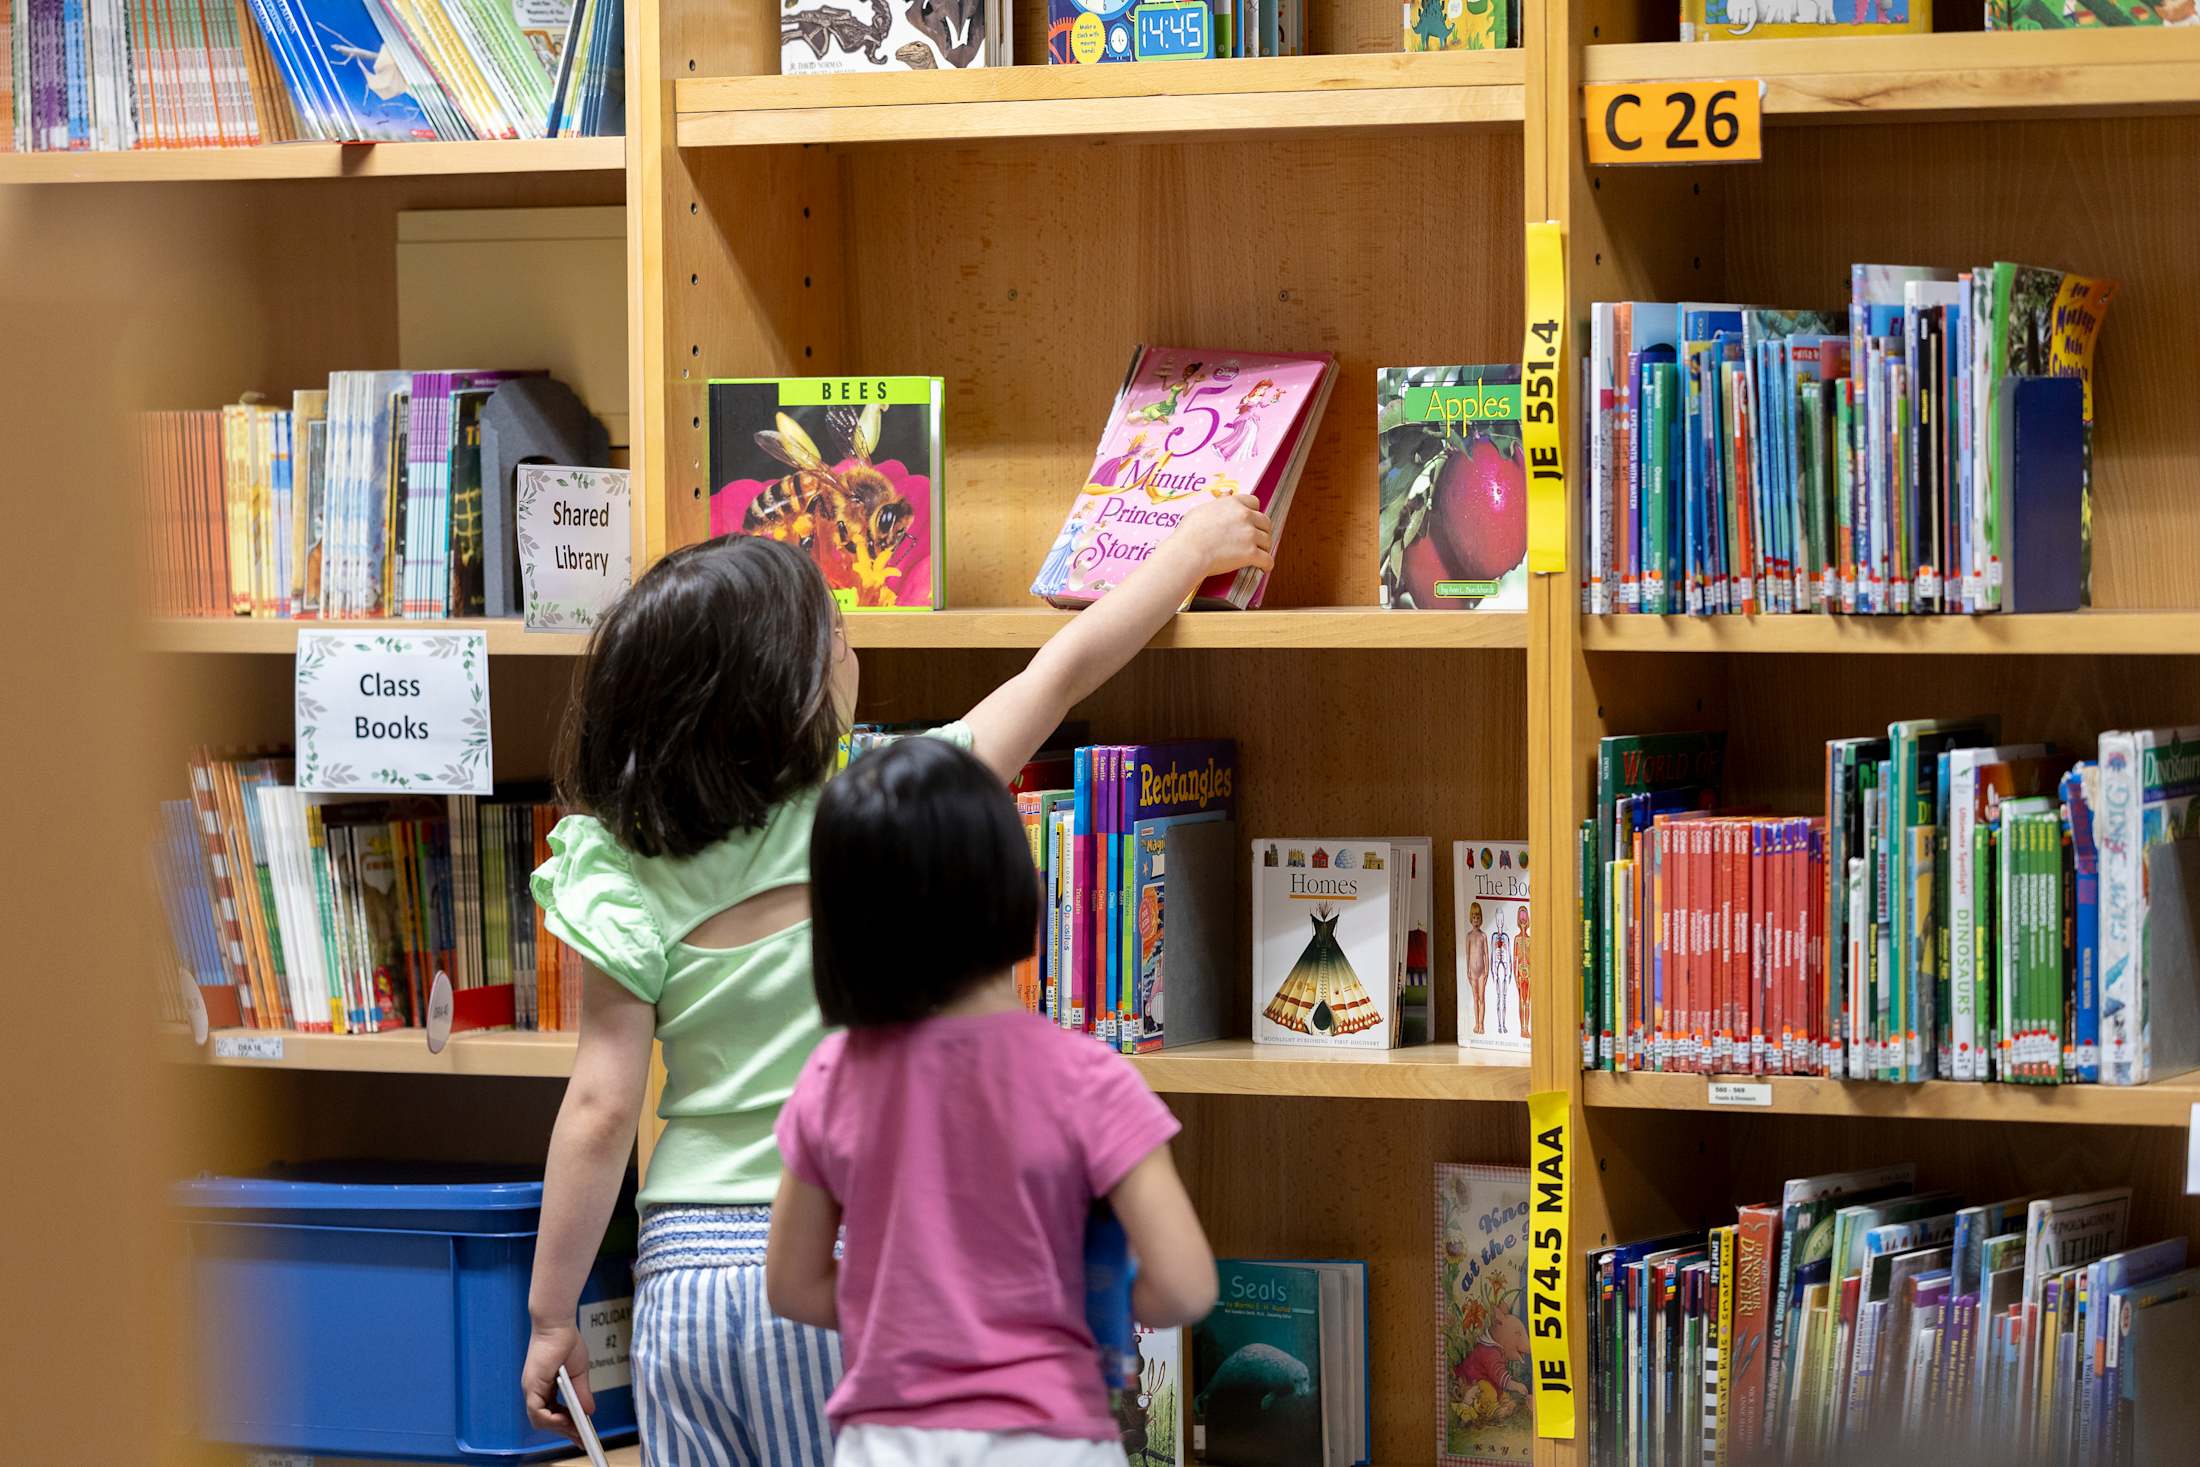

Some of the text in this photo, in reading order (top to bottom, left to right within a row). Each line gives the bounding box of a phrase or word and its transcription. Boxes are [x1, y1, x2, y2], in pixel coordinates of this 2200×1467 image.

[1142, 12, 1201, 49] 14:45
[1604, 90, 1740, 151] C 26
[822, 381, 887, 400] BEES
[1526, 319, 1564, 481] JE 551.4
[1164, 384, 1233, 458] 5
[1425, 377, 1511, 438] Apples
[1120, 459, 1207, 492] Minute
[1629, 408, 1637, 510] EXPERIMENTS WITH WATER
[553, 500, 609, 527] Shared
[555, 545, 609, 576] Library
[360, 672, 420, 697] Class
[355, 715, 429, 740] Books
[1139, 758, 1232, 808] Rectangles
[1290, 873, 1358, 896] Homes
[1474, 874, 1531, 897] The Bo
[1956, 807, 1970, 1016] Ultimate Spotlight DINOSAURS
[1479, 1201, 1529, 1234] Kno
[1783, 1231, 1792, 1247] MY
[1462, 1234, 1517, 1292] at the
[1534, 1125, 1573, 1394] JE 574.5 MAA
[1751, 1242, 1764, 1310] DINOSAUR
[1779, 1248, 1790, 1291] TOURIST
[1231, 1275, 1287, 1301] Seals
[1738, 1236, 1756, 1317] DANGER!
[1775, 1291, 1787, 1322] GUIDE
[1773, 1322, 1783, 1337] TO
[2084, 1364, 2093, 1386] Walk
